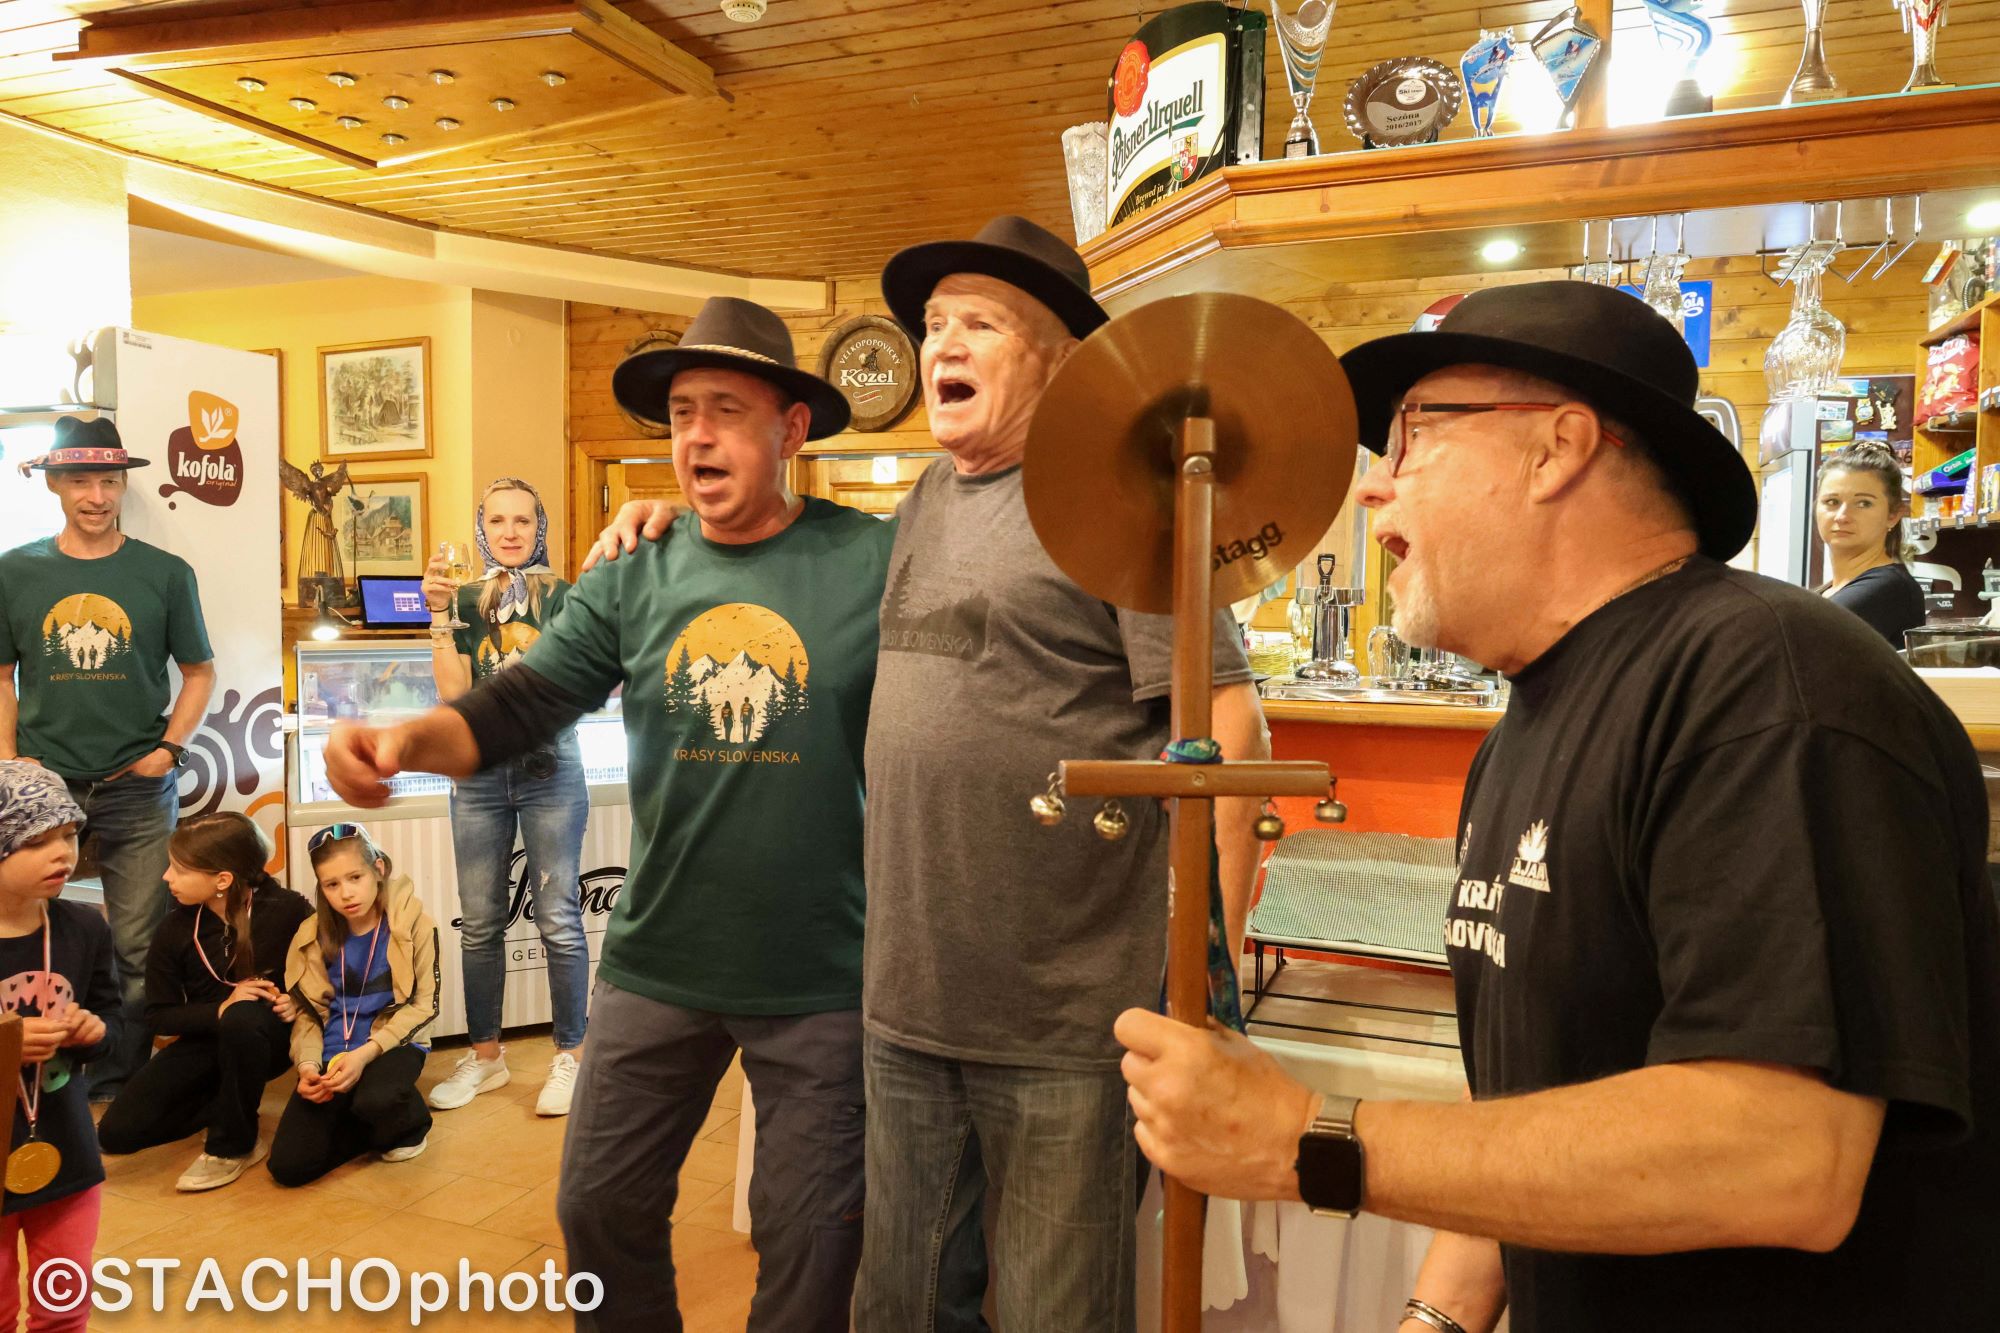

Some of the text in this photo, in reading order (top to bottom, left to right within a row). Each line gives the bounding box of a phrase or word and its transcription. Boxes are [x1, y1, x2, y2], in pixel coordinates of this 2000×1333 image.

[1385, 120, 1422, 131] 2016/2017
[1386, 113, 1420, 123] Sezóna
[1112, 126, 1149, 192] Pilsner
[1148, 79, 1204, 139] Urquell
[1135, 184, 1157, 206] Brewed
[840, 368, 899, 388] Kozel
[177, 451, 235, 486] kofola
[206, 477, 238, 491] original
[75, 673, 127, 681] SLOVENSKA
[718, 749, 800, 764] SLOVENSKA
